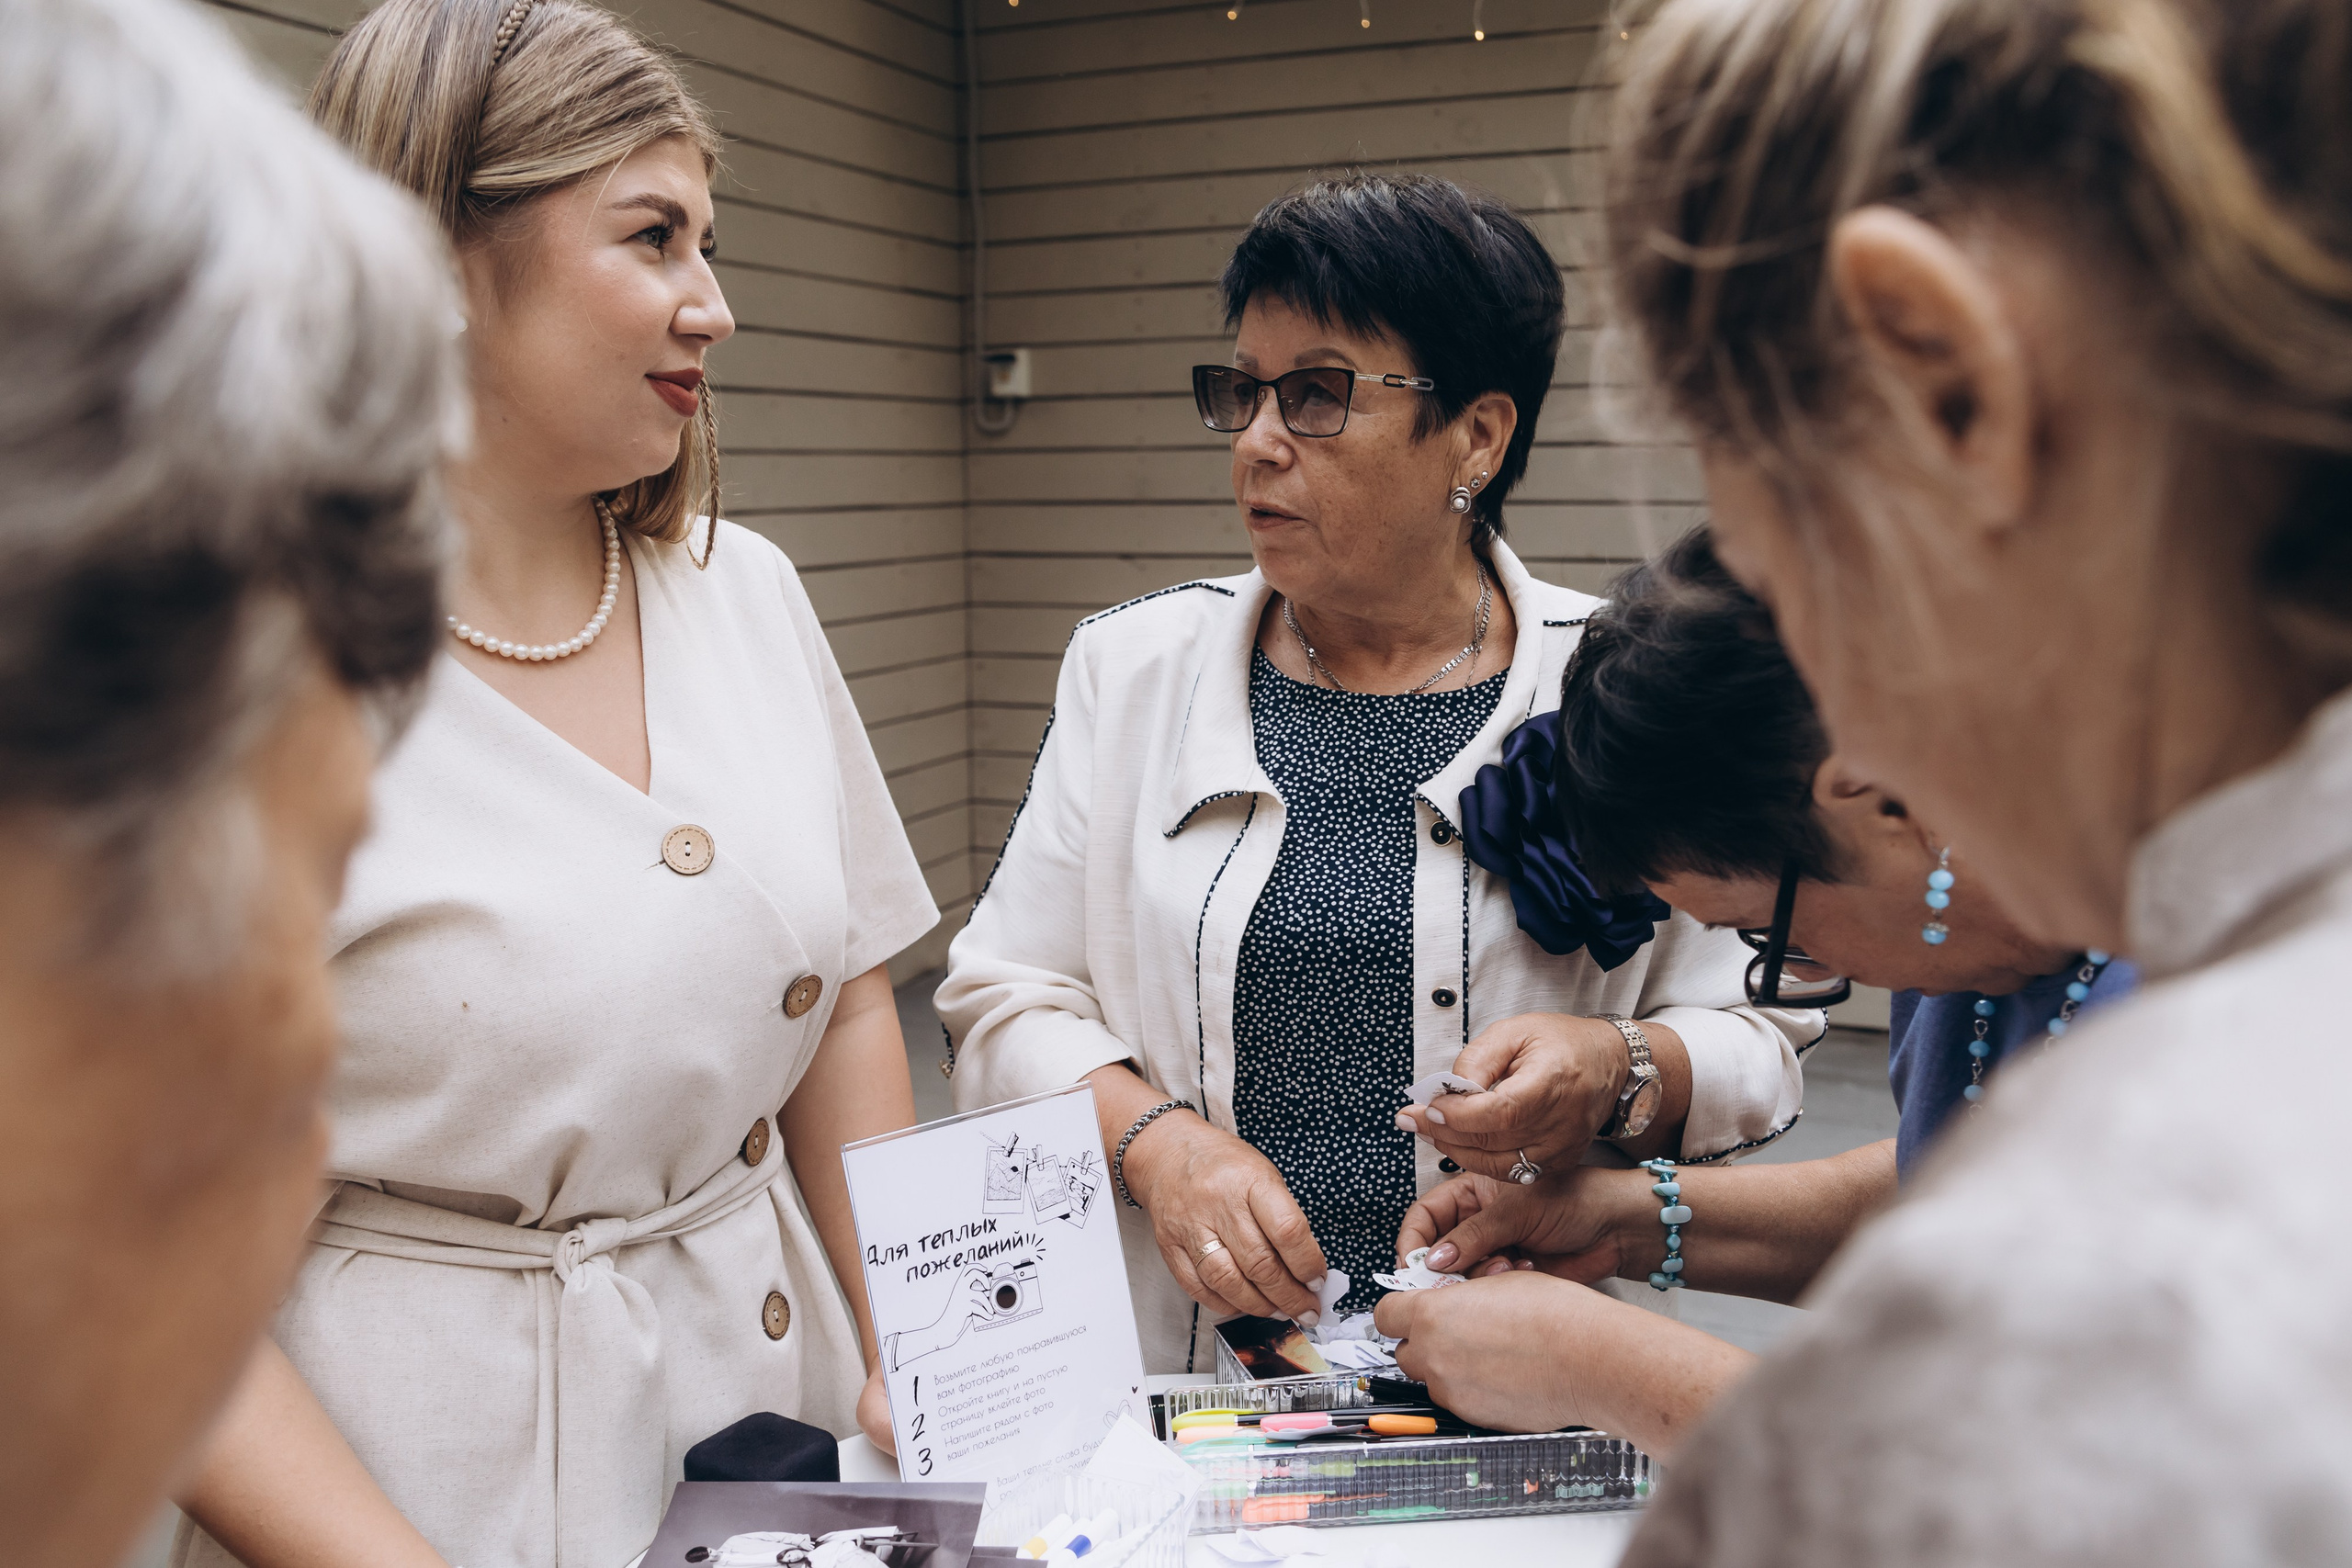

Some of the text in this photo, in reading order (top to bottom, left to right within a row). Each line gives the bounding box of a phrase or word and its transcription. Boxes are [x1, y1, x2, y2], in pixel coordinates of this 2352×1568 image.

[867, 1218, 998, 1267] Для теплых
[933, 1325, 1088, 1386] Возьмите любую понравившуюся
[913, 1376, 920, 1406] 1
[936, 1364, 1020, 1401] вам фотографию
[938, 1392, 984, 1418] Откройте
[987, 1386, 1011, 1402] книгу
[1023, 1377, 1035, 1388] на
[1036, 1364, 1069, 1383] пустую
[911, 1413, 925, 1442] 2
[941, 1387, 1046, 1432] страницу вклейте фото
[944, 1425, 992, 1449] Напишите
[994, 1413, 1022, 1432] рядом
[1032, 1401, 1055, 1416] фото
[918, 1448, 933, 1476] 3
[947, 1427, 1022, 1461] ваши пожелания
[1056, 1448, 1080, 1464] слова
